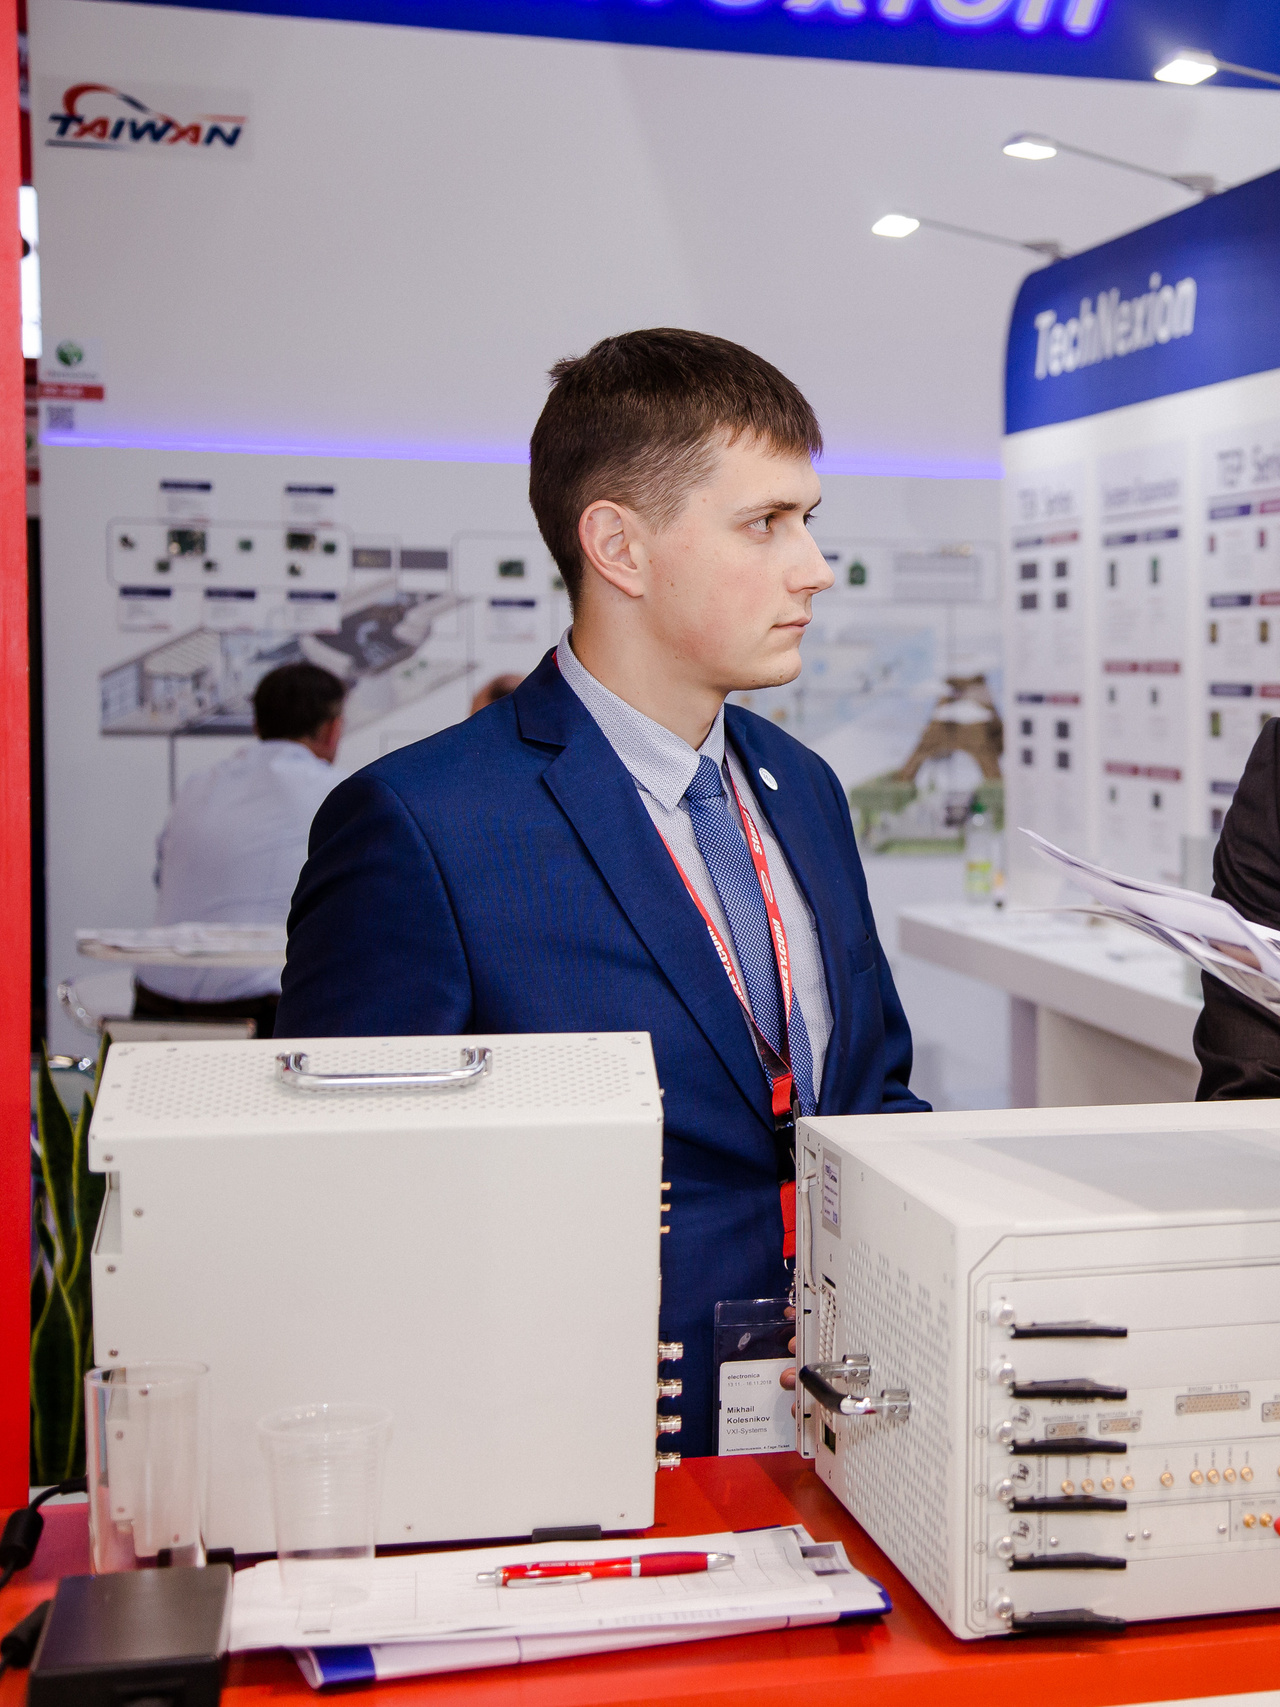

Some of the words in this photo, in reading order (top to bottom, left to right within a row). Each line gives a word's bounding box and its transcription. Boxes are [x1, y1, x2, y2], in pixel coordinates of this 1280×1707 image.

[48, 112, 243, 147] TAIWAN
[1033, 270, 1198, 381] TechNexion
[726, 1405, 755, 1414] Mikhail
[726, 1416, 771, 1424] Kolesnikov
[726, 1427, 768, 1435] VXI-Systems
